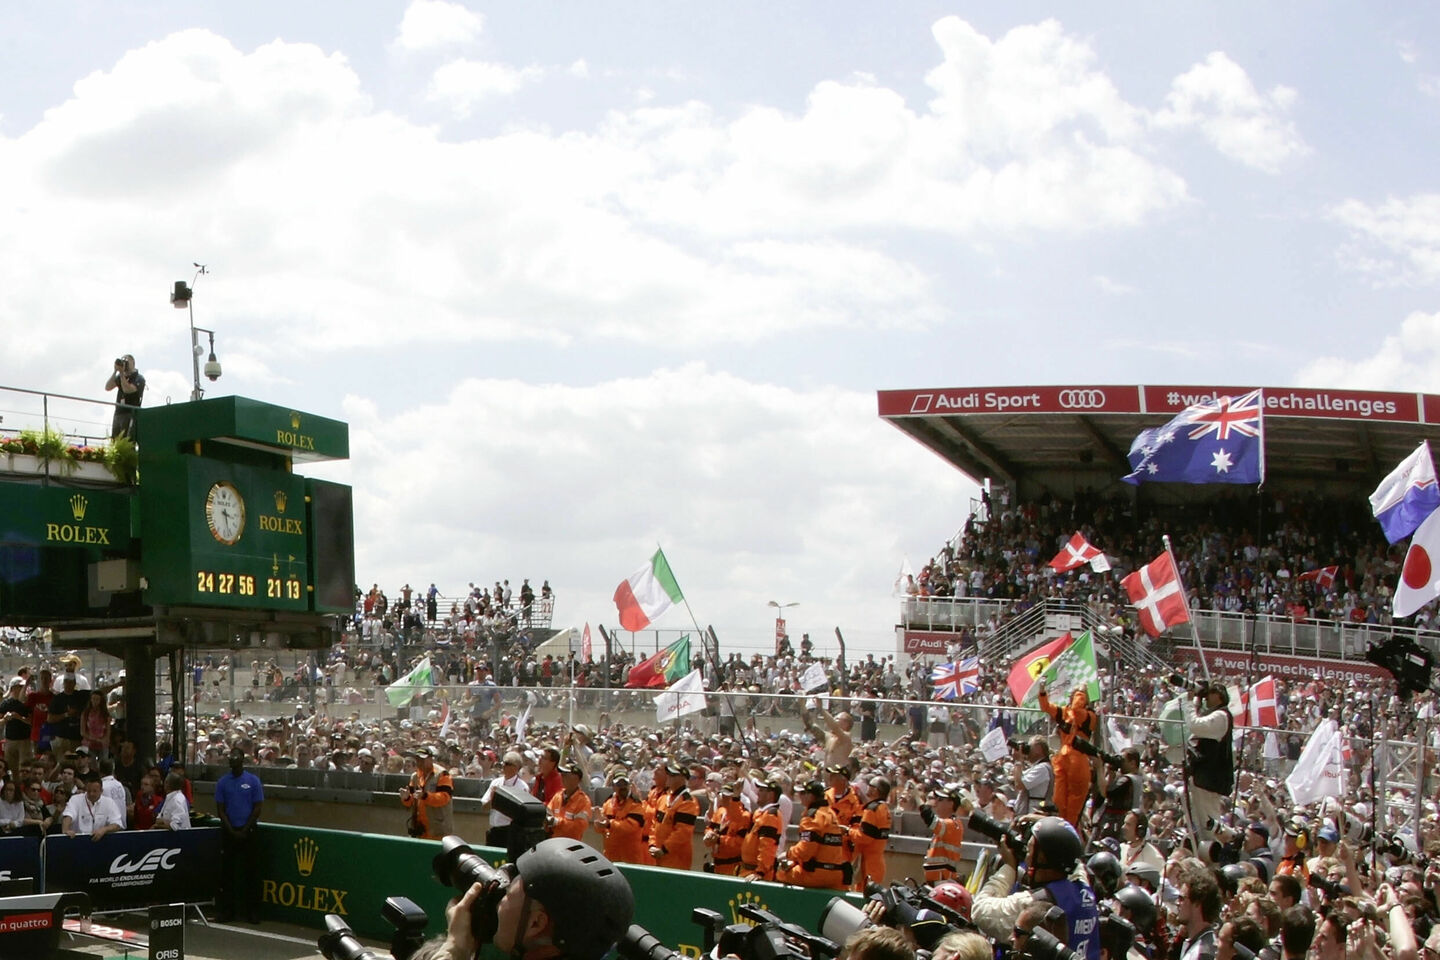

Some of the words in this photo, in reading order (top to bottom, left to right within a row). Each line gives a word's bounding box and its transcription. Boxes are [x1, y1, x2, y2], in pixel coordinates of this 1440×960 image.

[936, 394, 982, 409] Audi
[985, 392, 1041, 412] Sport
[276, 429, 314, 450] ROLEX
[46, 523, 110, 545] ROLEX
[259, 514, 303, 535] ROLEX
[198, 572, 215, 592] 24
[218, 574, 235, 594] 27
[239, 575, 254, 596] 56
[267, 578, 282, 598] 21
[286, 580, 300, 600] 13
[920, 640, 942, 648] Audi
[109, 848, 182, 874] WEC
[111, 880, 154, 888] CHAMPIONSHIP
[263, 879, 348, 916] ROLEX
[9, 917, 48, 930] quattro
[160, 918, 182, 928] BOSCH
[156, 949, 179, 960] ORIS
